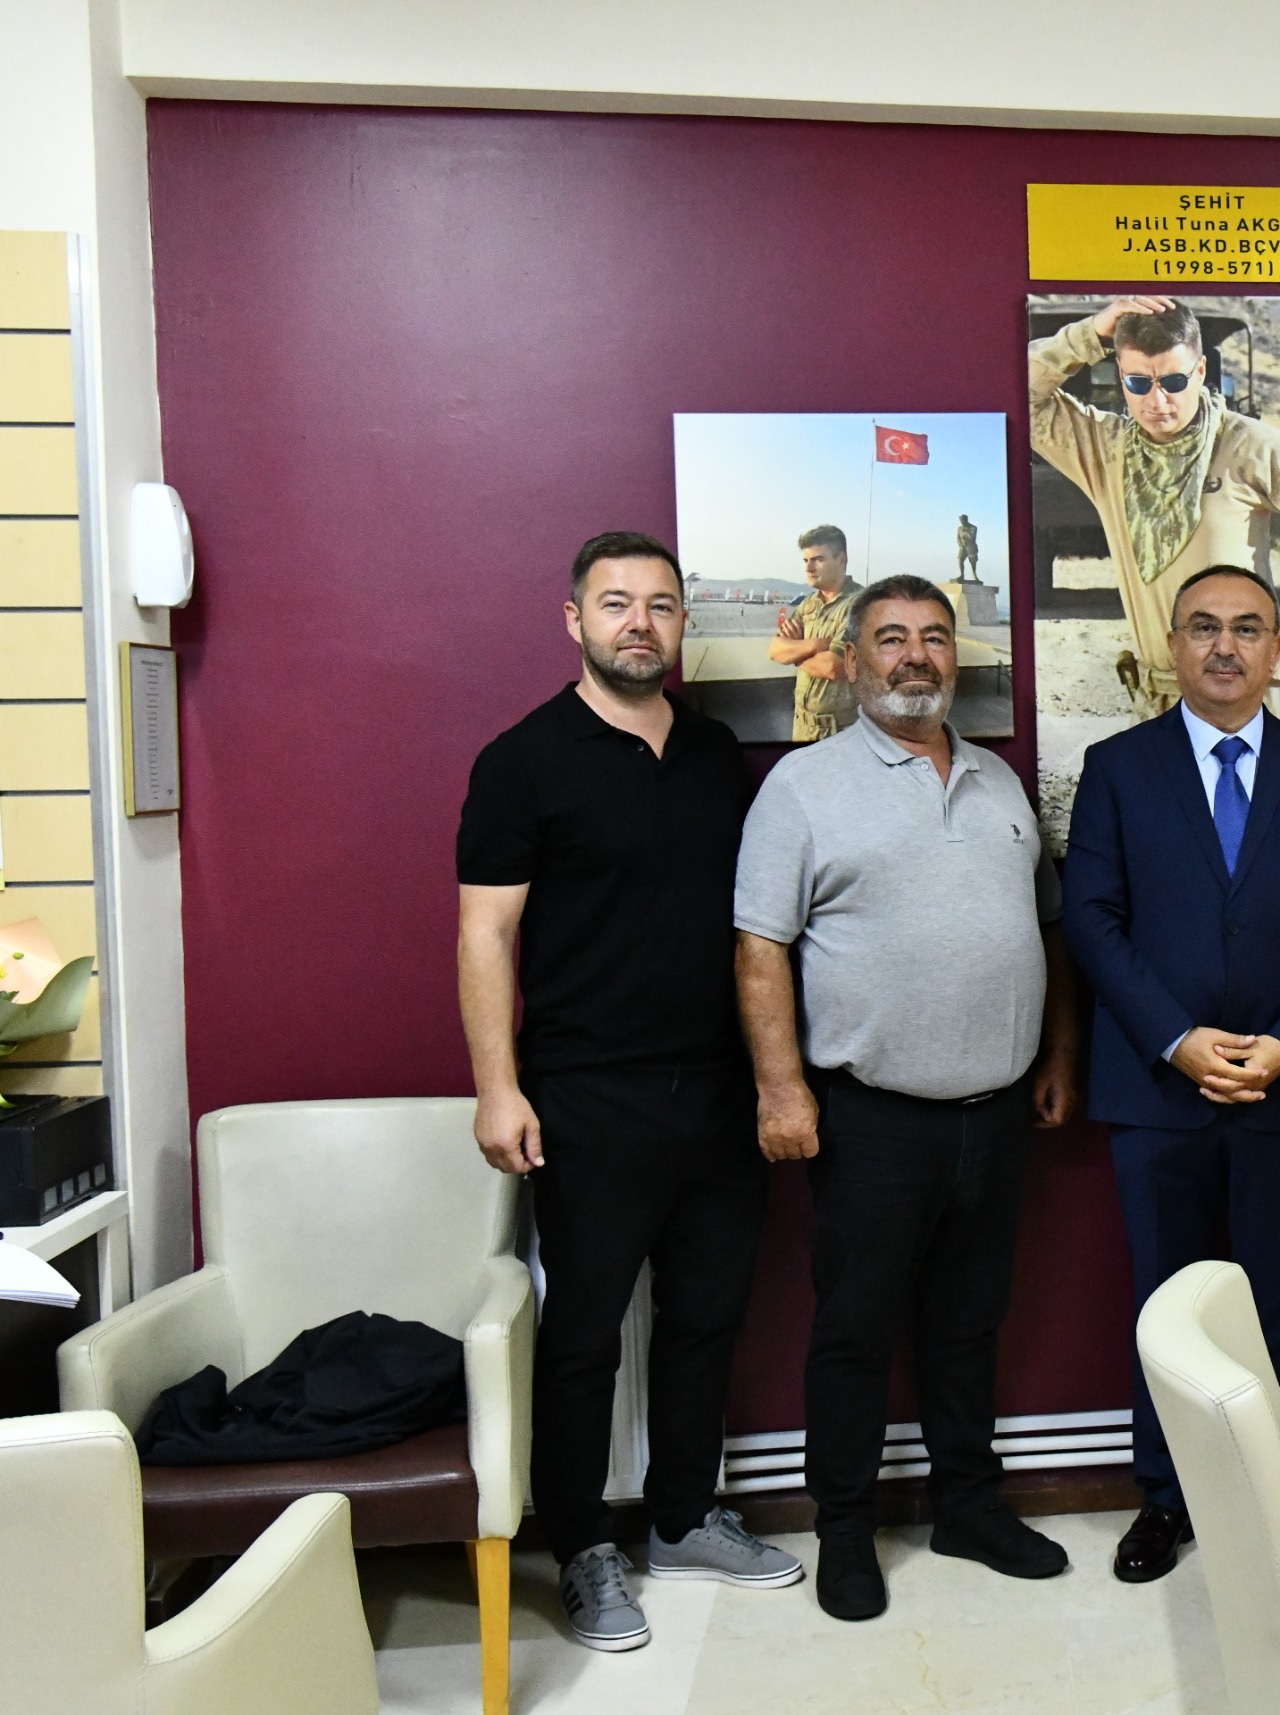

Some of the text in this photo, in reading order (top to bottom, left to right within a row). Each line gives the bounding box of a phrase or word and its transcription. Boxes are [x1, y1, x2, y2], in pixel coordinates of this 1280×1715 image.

[1179, 192, 1245, 211] ŞEHİT
[1115, 216, 1169, 231] Halil
[1176, 216, 1229, 232] Tuna
[1153, 258, 1274, 277] (1998-571)
